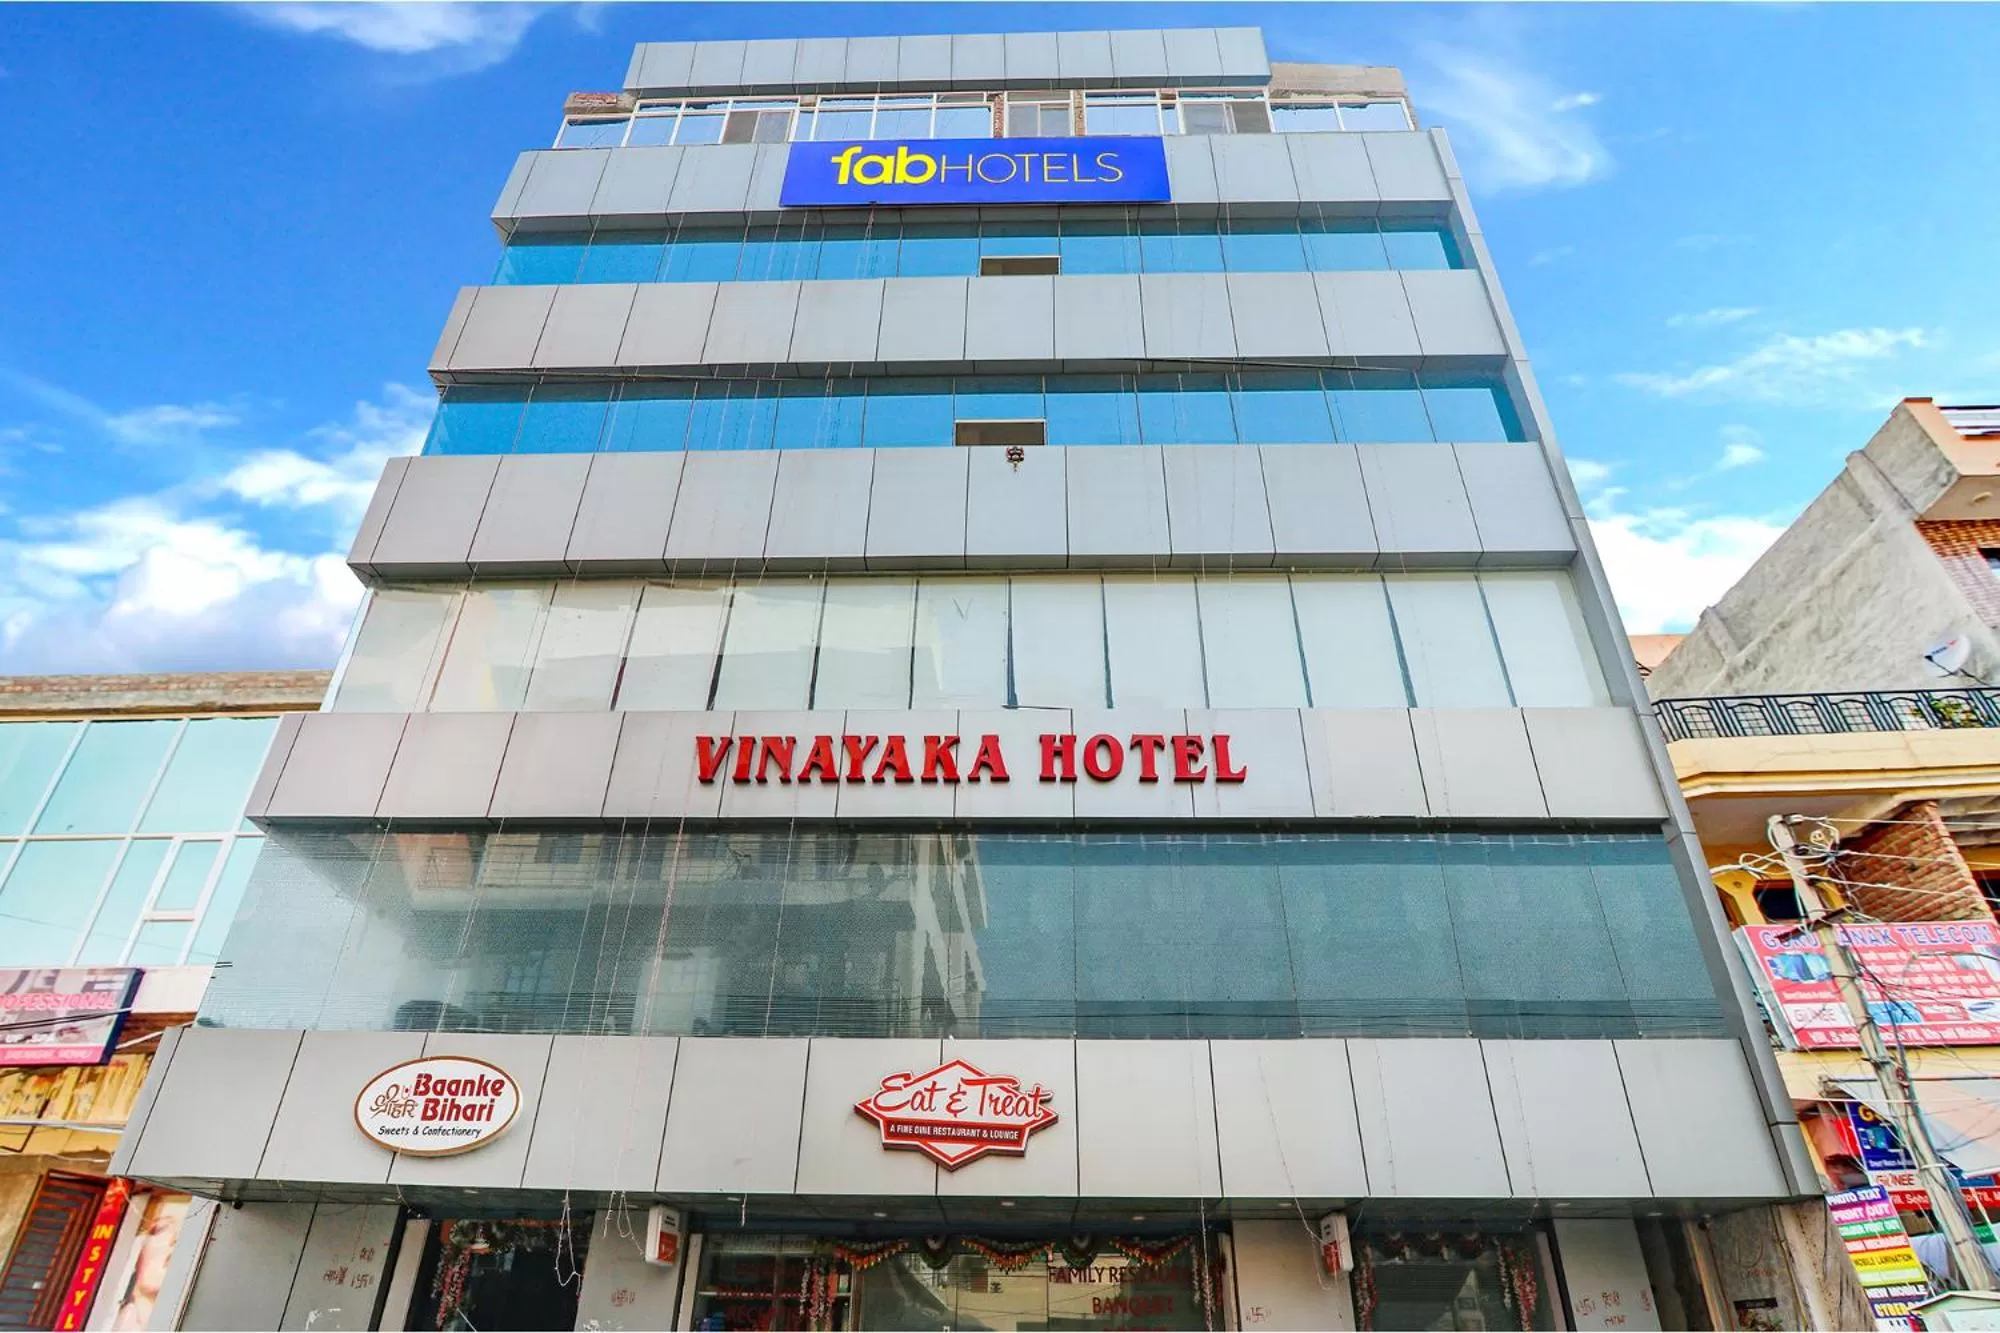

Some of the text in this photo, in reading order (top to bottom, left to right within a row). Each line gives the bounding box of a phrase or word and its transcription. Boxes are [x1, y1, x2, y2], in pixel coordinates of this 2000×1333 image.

[695, 734, 1248, 783] VINAYAKA HOTEL
[1898, 926, 1994, 945] TELECOM
[413, 1073, 506, 1097] Baanke
[873, 1072, 1053, 1118] Eat & Treat
[420, 1098, 496, 1122] Bihari
[378, 1126, 482, 1139] Sweets & Confectionery
[889, 1124, 1019, 1140] A FINE DINE RESTAURANT & LOUNGE
[92, 1224, 115, 1240] IN
[1048, 1266, 1105, 1284] FAMILY
